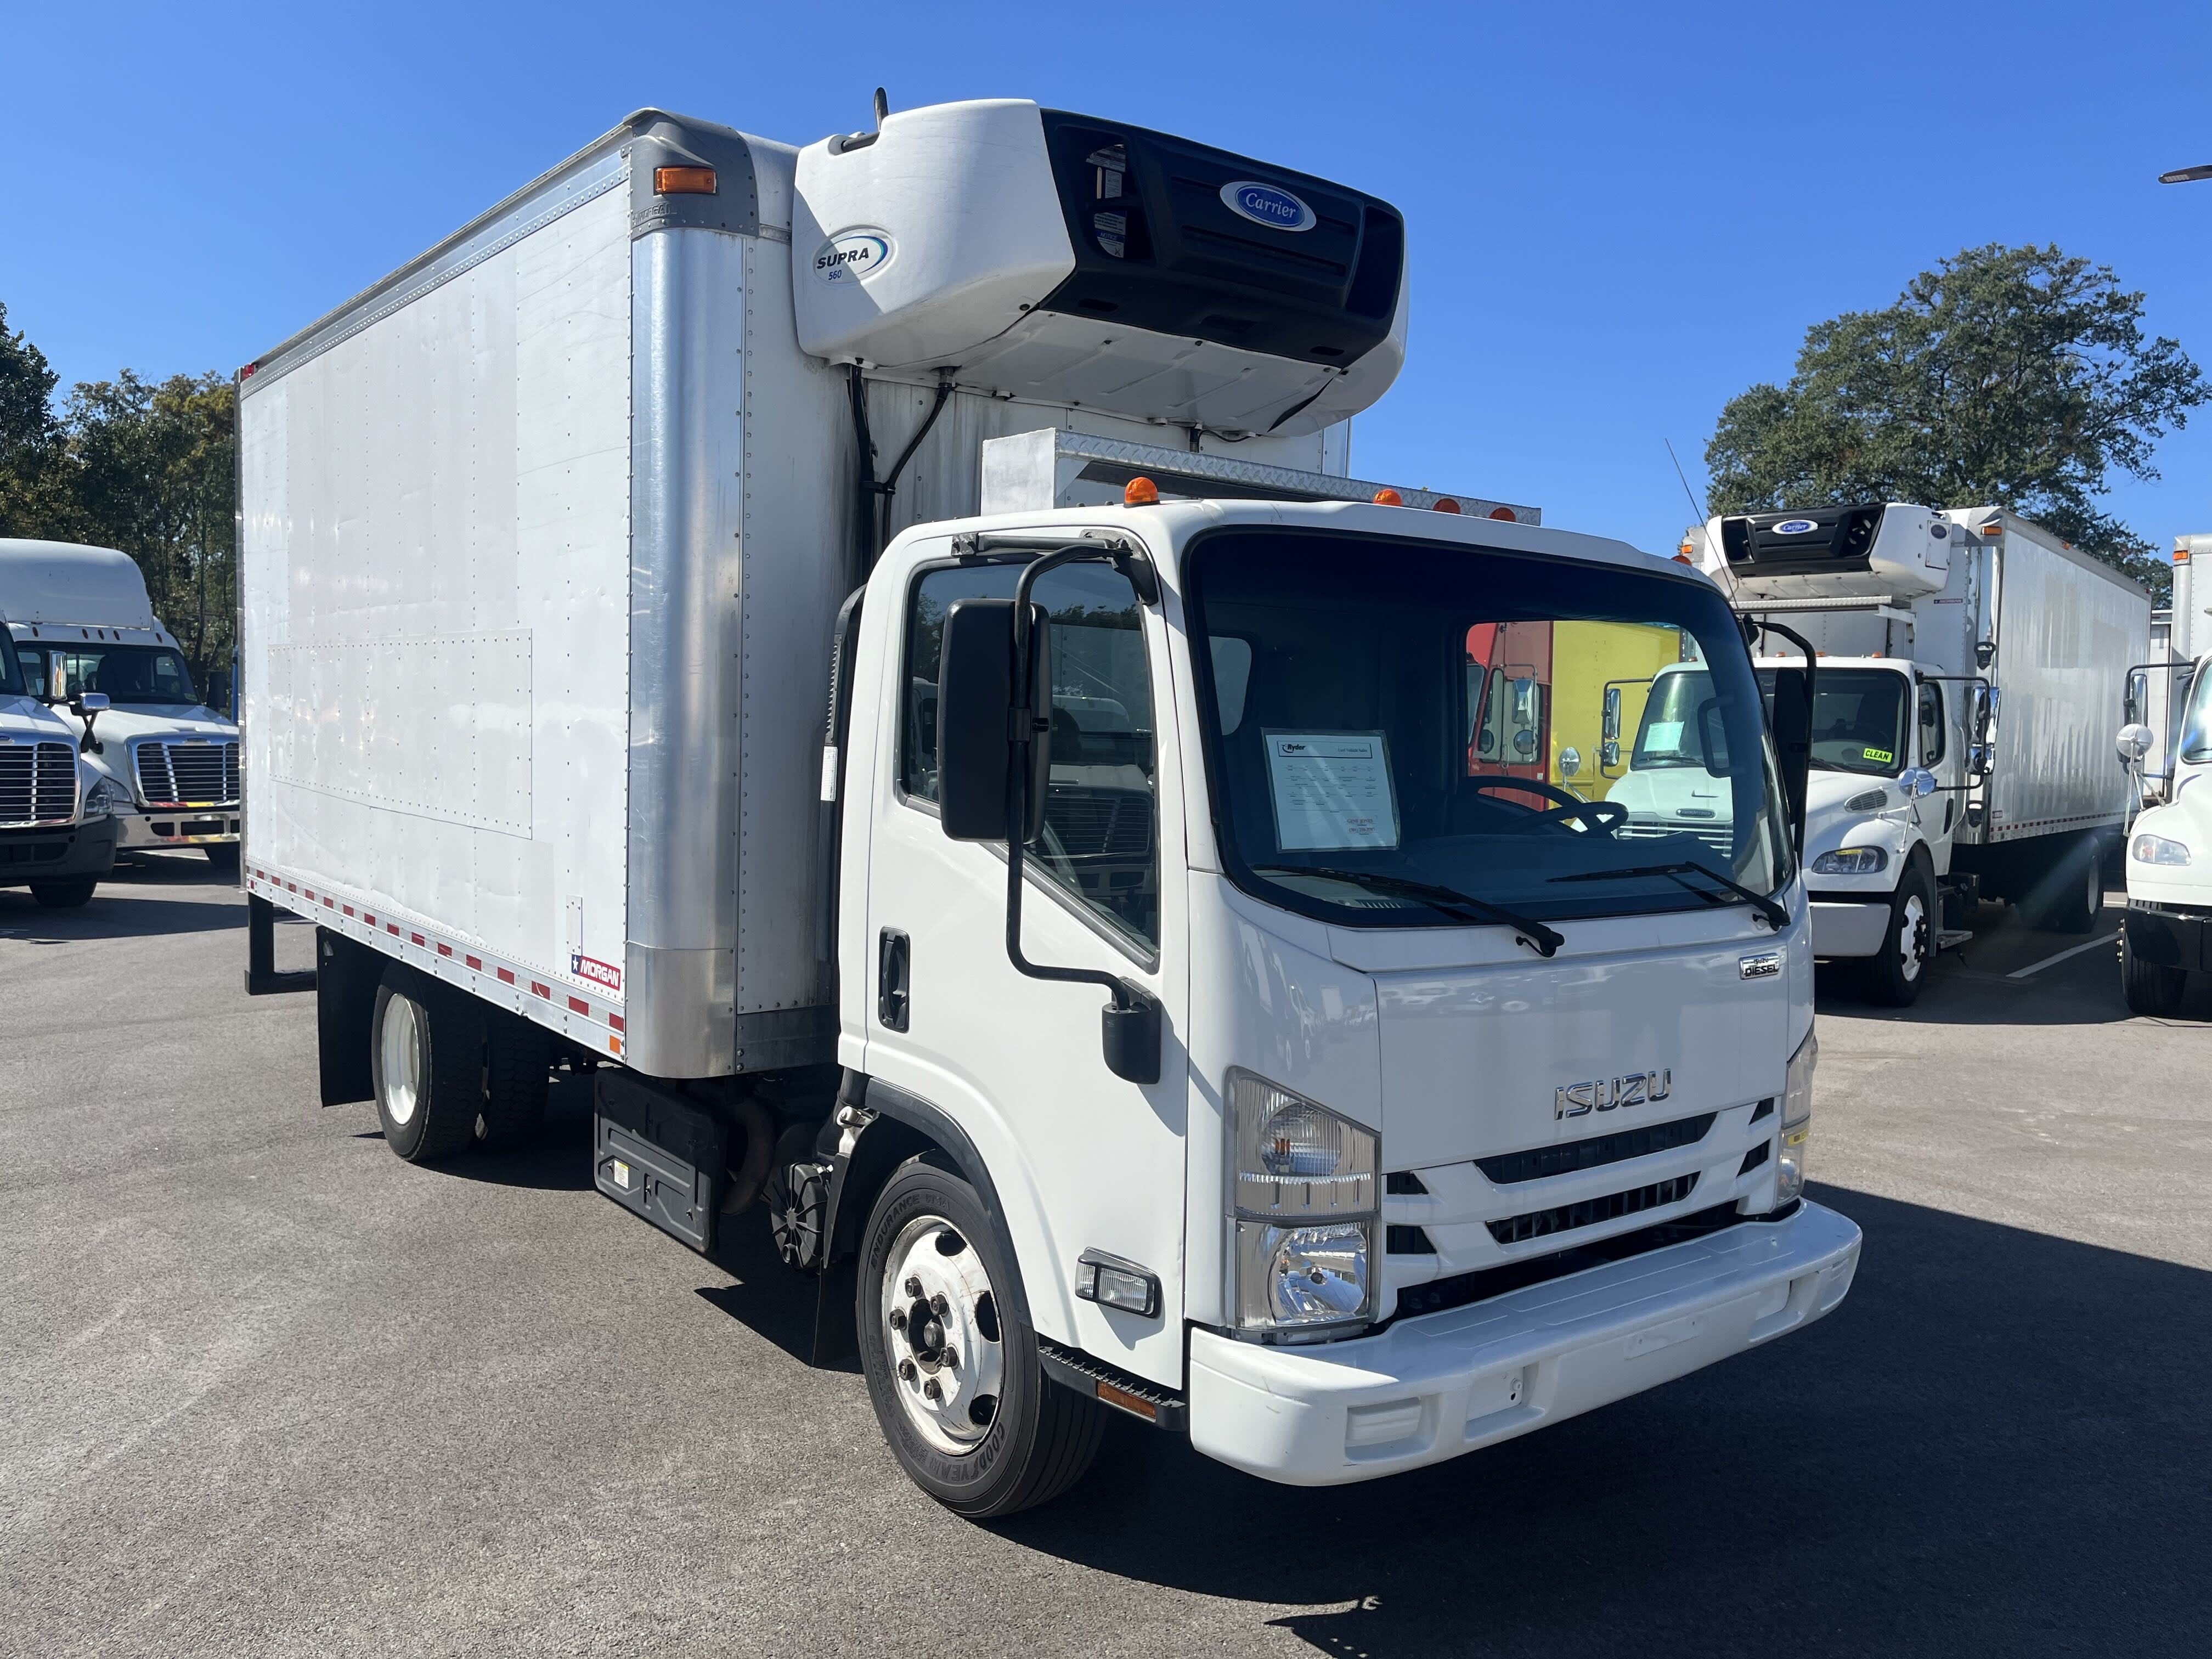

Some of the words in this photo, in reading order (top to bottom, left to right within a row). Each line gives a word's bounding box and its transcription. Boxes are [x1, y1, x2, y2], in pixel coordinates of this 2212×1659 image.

[1246, 193, 1296, 218] Carrier
[817, 247, 869, 269] SUPRA
[828, 270, 842, 280] 560
[1865, 750, 1889, 760] CLEAN
[580, 960, 619, 987] MORGAN
[1745, 964, 1779, 977] DIESEL
[1554, 1068, 1672, 1121] ISUZU
[871, 1194, 920, 1271] ENDURANCE
[929, 1421, 1006, 1481] GOODYEAR
